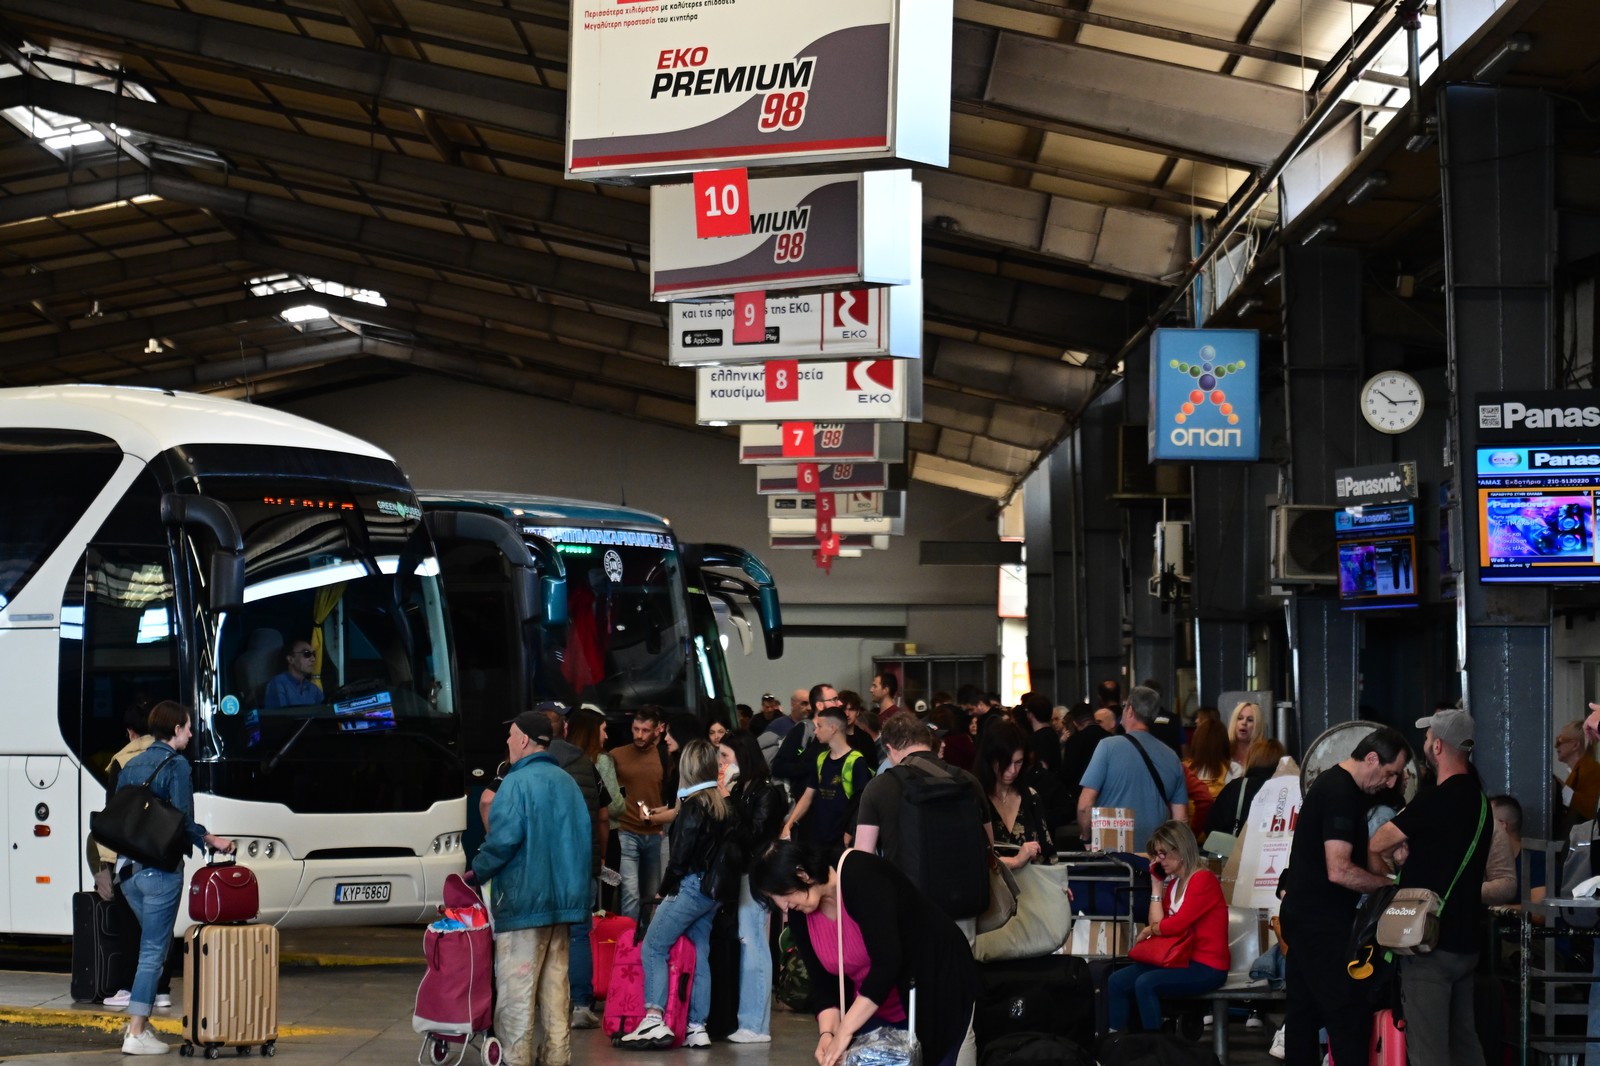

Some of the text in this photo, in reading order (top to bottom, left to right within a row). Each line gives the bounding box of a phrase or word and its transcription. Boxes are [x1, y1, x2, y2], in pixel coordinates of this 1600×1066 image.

[584, 8, 624, 19] Περισσότερα
[625, 5, 659, 14] χιλιόμετρα
[660, 4, 668, 12] με
[669, 0, 702, 10] καλύτερες
[584, 20, 622, 31] Μεγαλύτερη
[623, 17, 656, 28] προστασία
[669, 13, 698, 22] κινητήρα
[657, 47, 709, 70] EKO
[650, 60, 813, 100] PREMIUM
[761, 93, 804, 129] 98
[704, 184, 740, 217] 10
[750, 208, 808, 234] MIUM
[776, 232, 804, 261] 98
[682, 310, 697, 319] και
[699, 309, 712, 318] τις
[744, 303, 755, 327] 9
[771, 305, 786, 315] της
[706, 336, 720, 344] Store
[765, 334, 778, 342] Play
[842, 330, 867, 338] EKO
[776, 369, 788, 390] 8
[710, 386, 765, 401] καυσίμω
[858, 393, 891, 403] EKO
[792, 430, 804, 446] 7
[823, 430, 841, 447] 98
[1535, 452, 1600, 467] Panas
[804, 469, 812, 484] 6
[834, 464, 851, 479] 98
[1345, 471, 1401, 497] Panasonic
[822, 499, 829, 511] 5
[821, 523, 827, 534] 4
